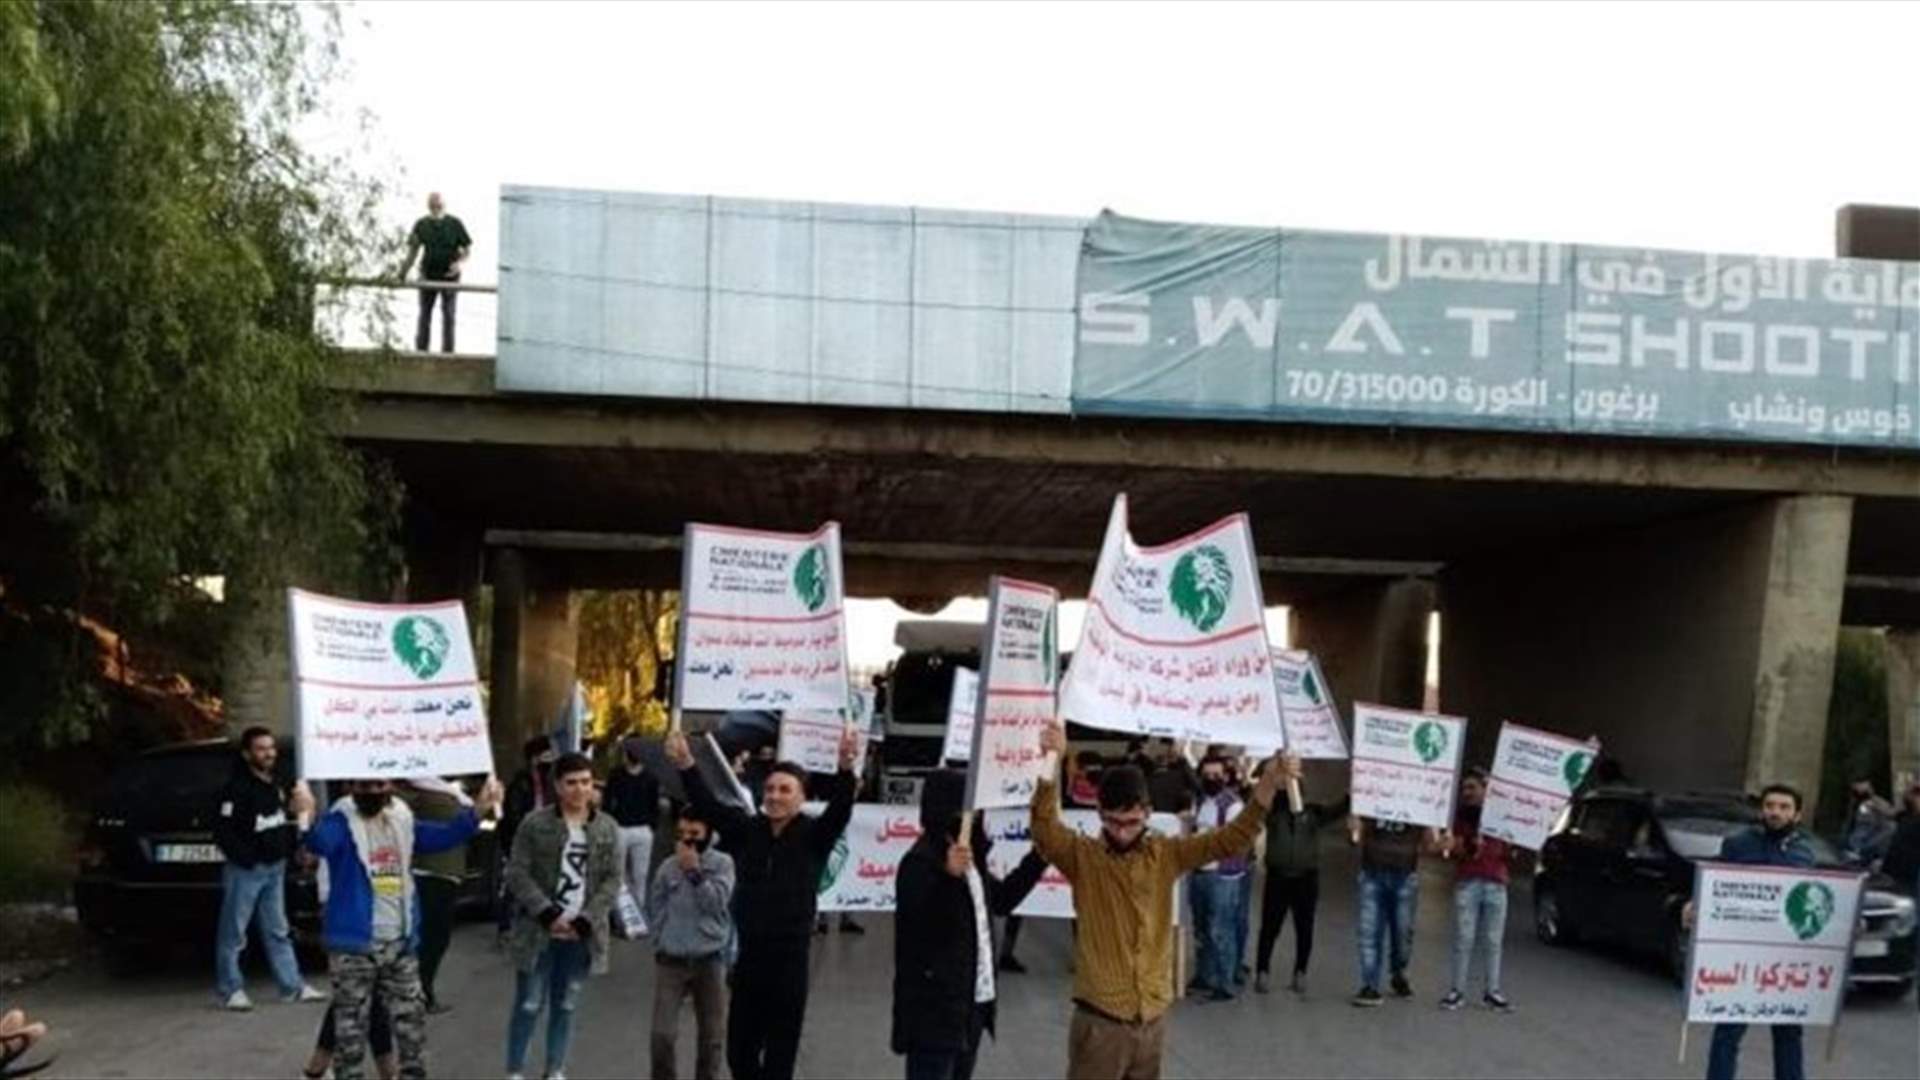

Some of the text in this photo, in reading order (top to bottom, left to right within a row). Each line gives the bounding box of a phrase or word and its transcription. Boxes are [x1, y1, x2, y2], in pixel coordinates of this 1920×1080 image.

[1577, 253, 1668, 305] في
[1286, 369, 1447, 405] 70/315000
[1454, 377, 1548, 415] الكورة
[1573, 384, 1660, 421] برغون
[1728, 390, 1826, 433] ونشاب
[1753, 961, 1812, 993] تتركوا
[1817, 963, 1835, 991] لا
